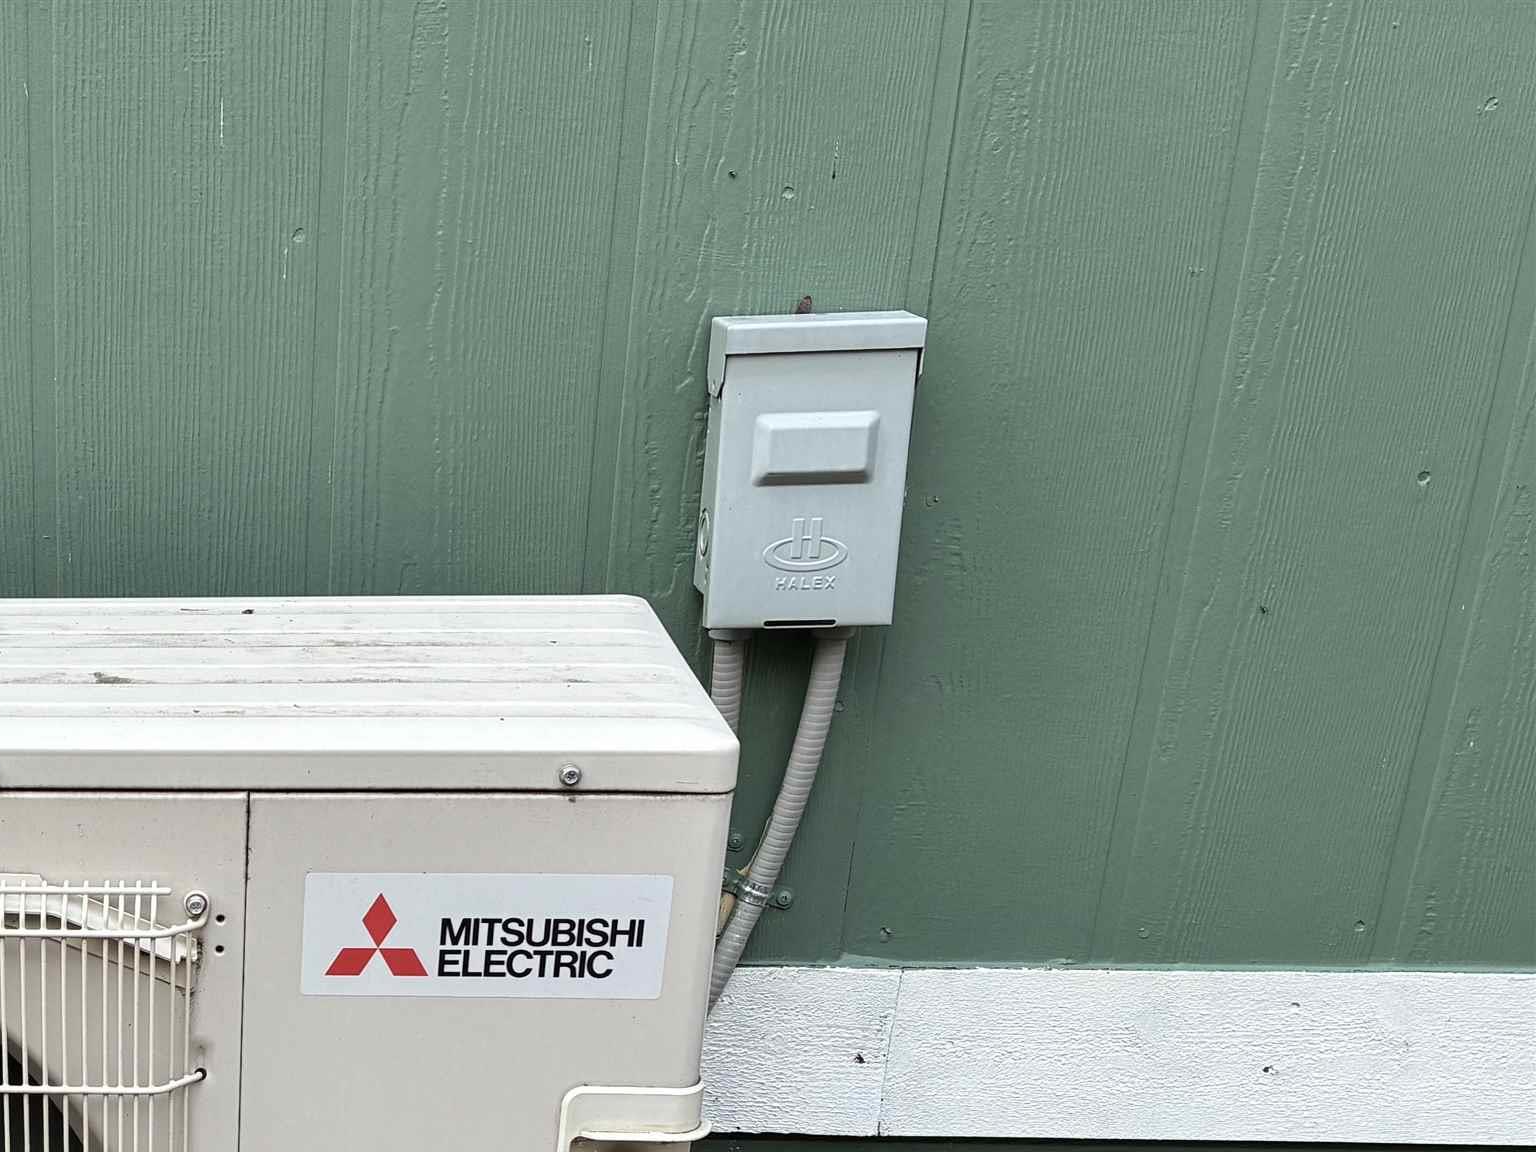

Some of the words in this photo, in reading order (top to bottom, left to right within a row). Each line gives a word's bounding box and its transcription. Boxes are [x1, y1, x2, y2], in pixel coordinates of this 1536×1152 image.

[775, 575, 837, 592] HALEX
[439, 917, 646, 949] MITSUBISHI
[437, 949, 615, 980] ELECTRIC
